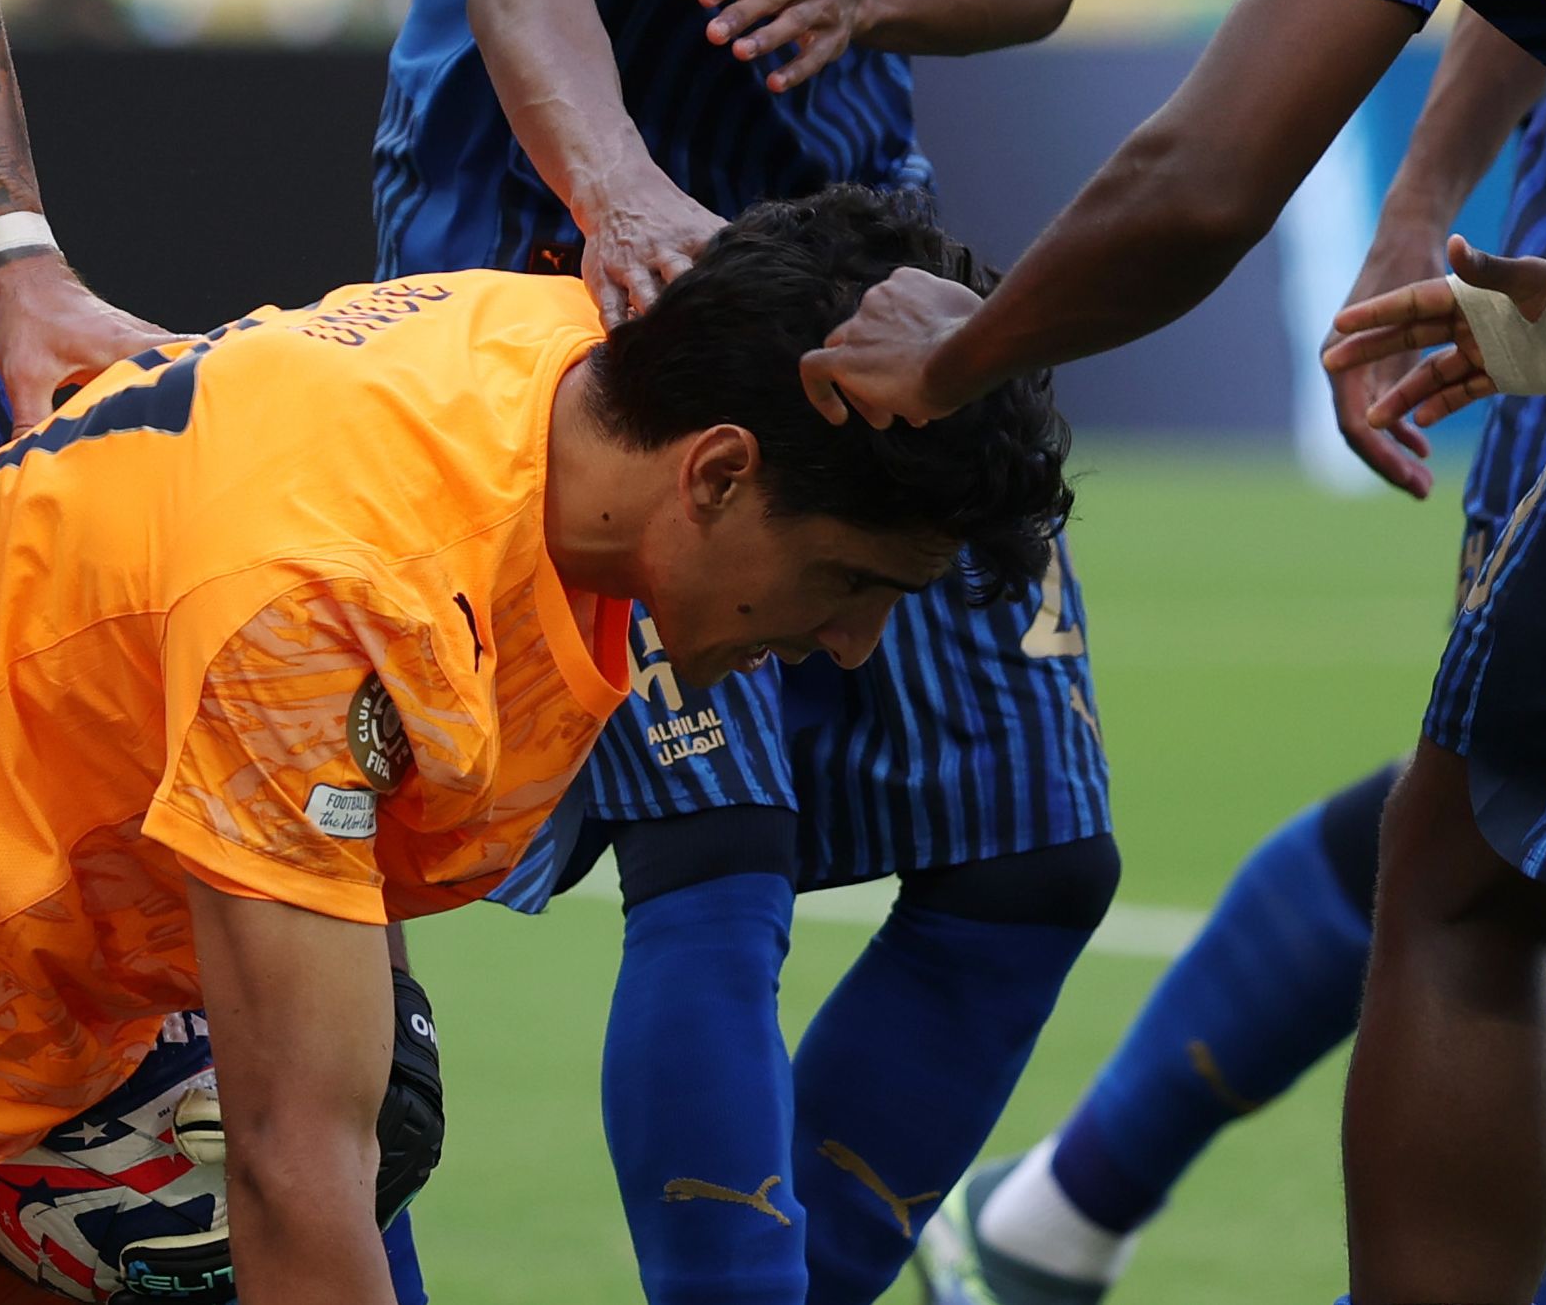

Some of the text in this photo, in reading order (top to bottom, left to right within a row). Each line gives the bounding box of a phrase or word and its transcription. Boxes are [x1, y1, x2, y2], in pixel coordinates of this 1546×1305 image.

[358, 697, 372, 743] CLUB
[646, 707, 723, 746] ALHILAL
[366, 750, 391, 781] FIFA
[319, 810, 341, 828] the
